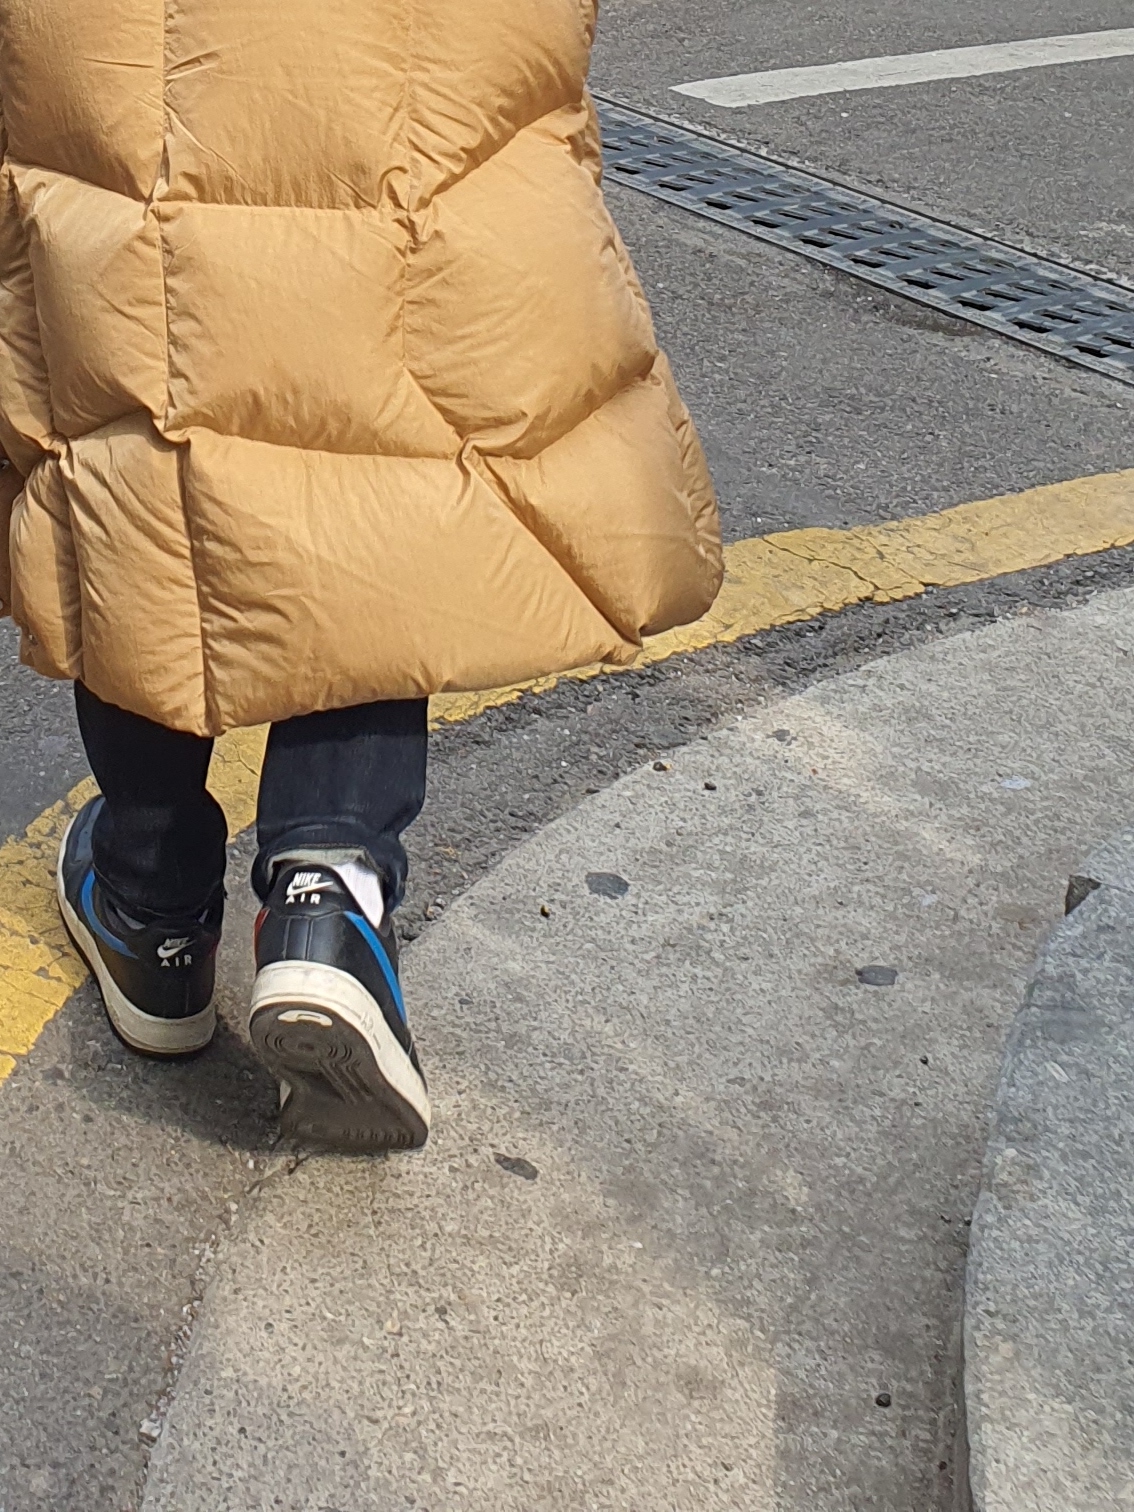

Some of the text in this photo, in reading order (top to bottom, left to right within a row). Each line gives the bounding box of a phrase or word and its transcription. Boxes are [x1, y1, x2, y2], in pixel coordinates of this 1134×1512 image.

[292, 872, 322, 887] NIKE
[285, 893, 321, 905] AIR
[160, 954, 193, 967] AIR
